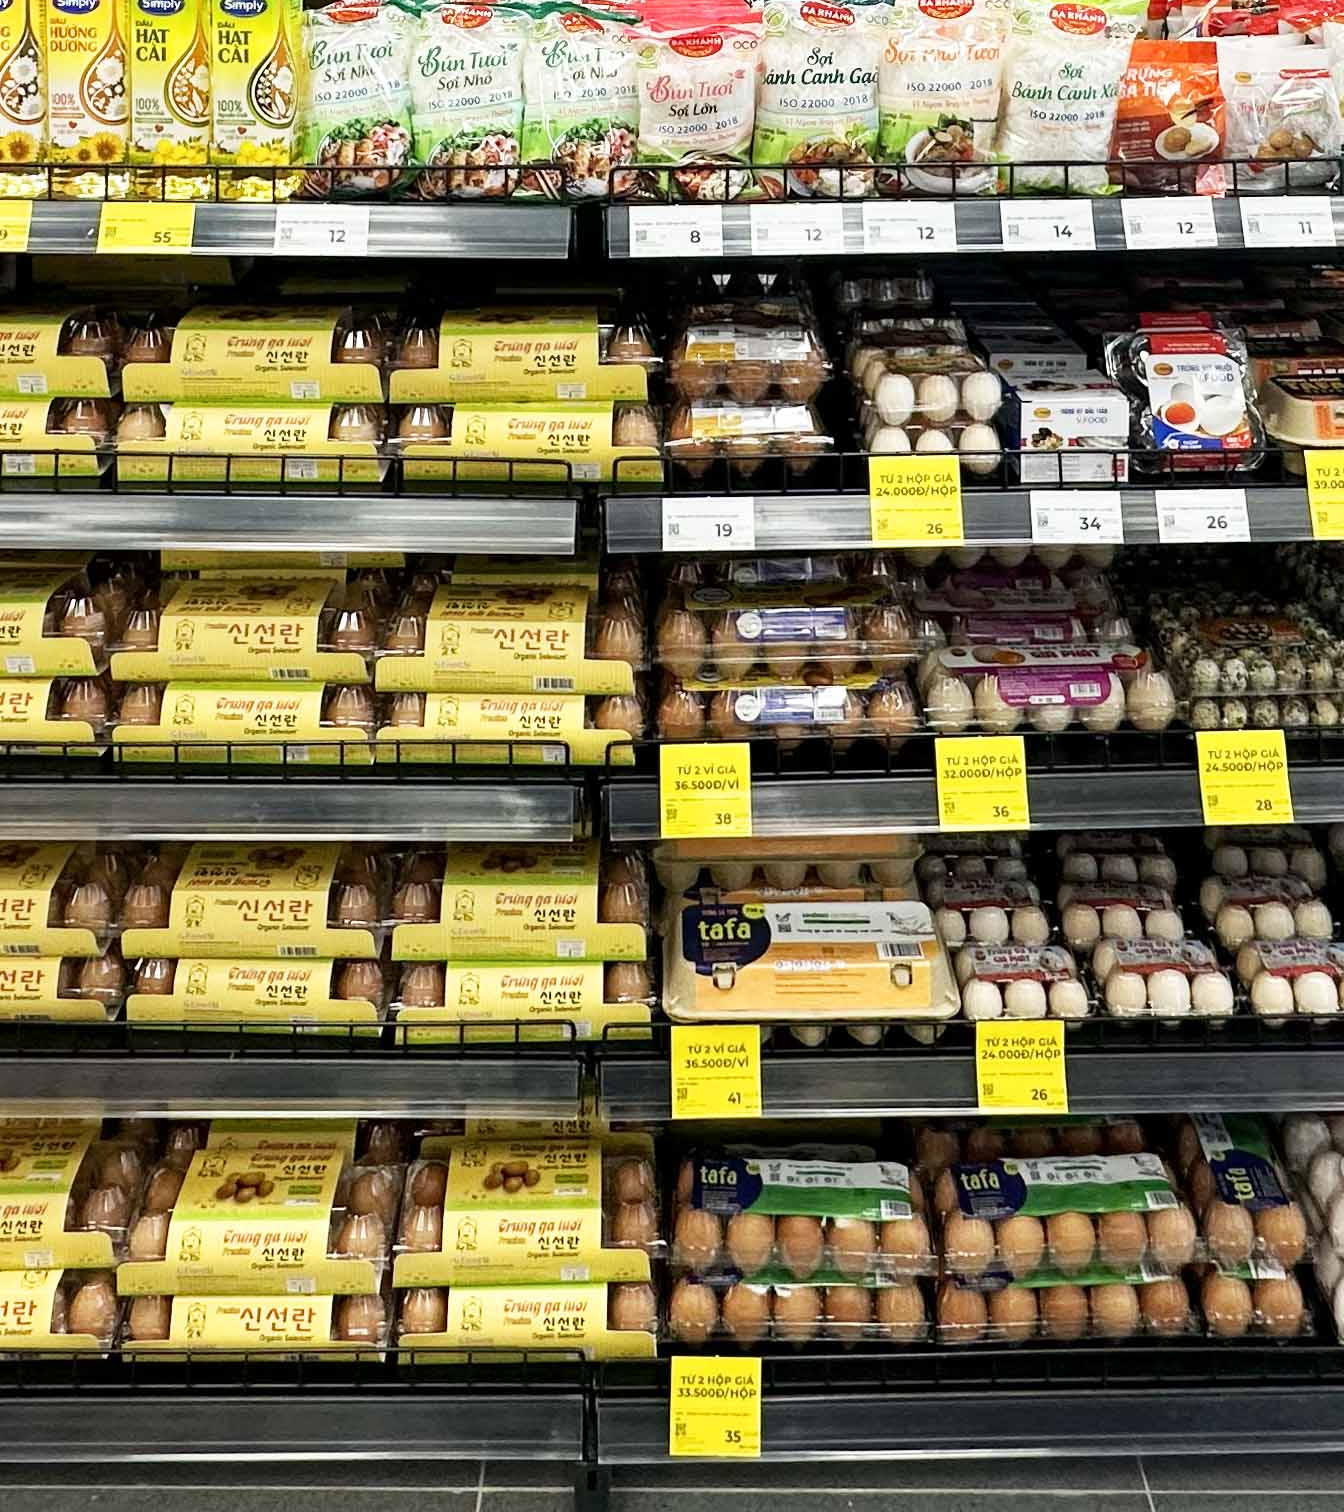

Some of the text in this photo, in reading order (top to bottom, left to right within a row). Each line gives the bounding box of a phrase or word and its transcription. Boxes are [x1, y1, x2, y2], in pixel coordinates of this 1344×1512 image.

[418, 46, 465, 78] Bún
[779, 94, 868, 109] ISO 22000 2018
[917, 227, 935, 240] 12
[1053, 226, 1072, 239] 14
[1176, 222, 1193, 234] 12
[153, 231, 171, 243] 55
[690, 231, 701, 243] 8
[897, 474, 903, 484] 2
[875, 485, 958, 499] 24.000Đ/HỘP
[1080, 517, 1102, 531] 34
[1207, 515, 1227, 529] 26
[714, 522, 732, 537] 19
[992, 806, 1009, 819] 36
[1255, 800, 1272, 812] 28
[698, 919, 751, 942] tafa
[728, 1092, 742, 1104] 41
[699, 1165, 737, 1186] tafa
[725, 1429, 741, 1443] 35
